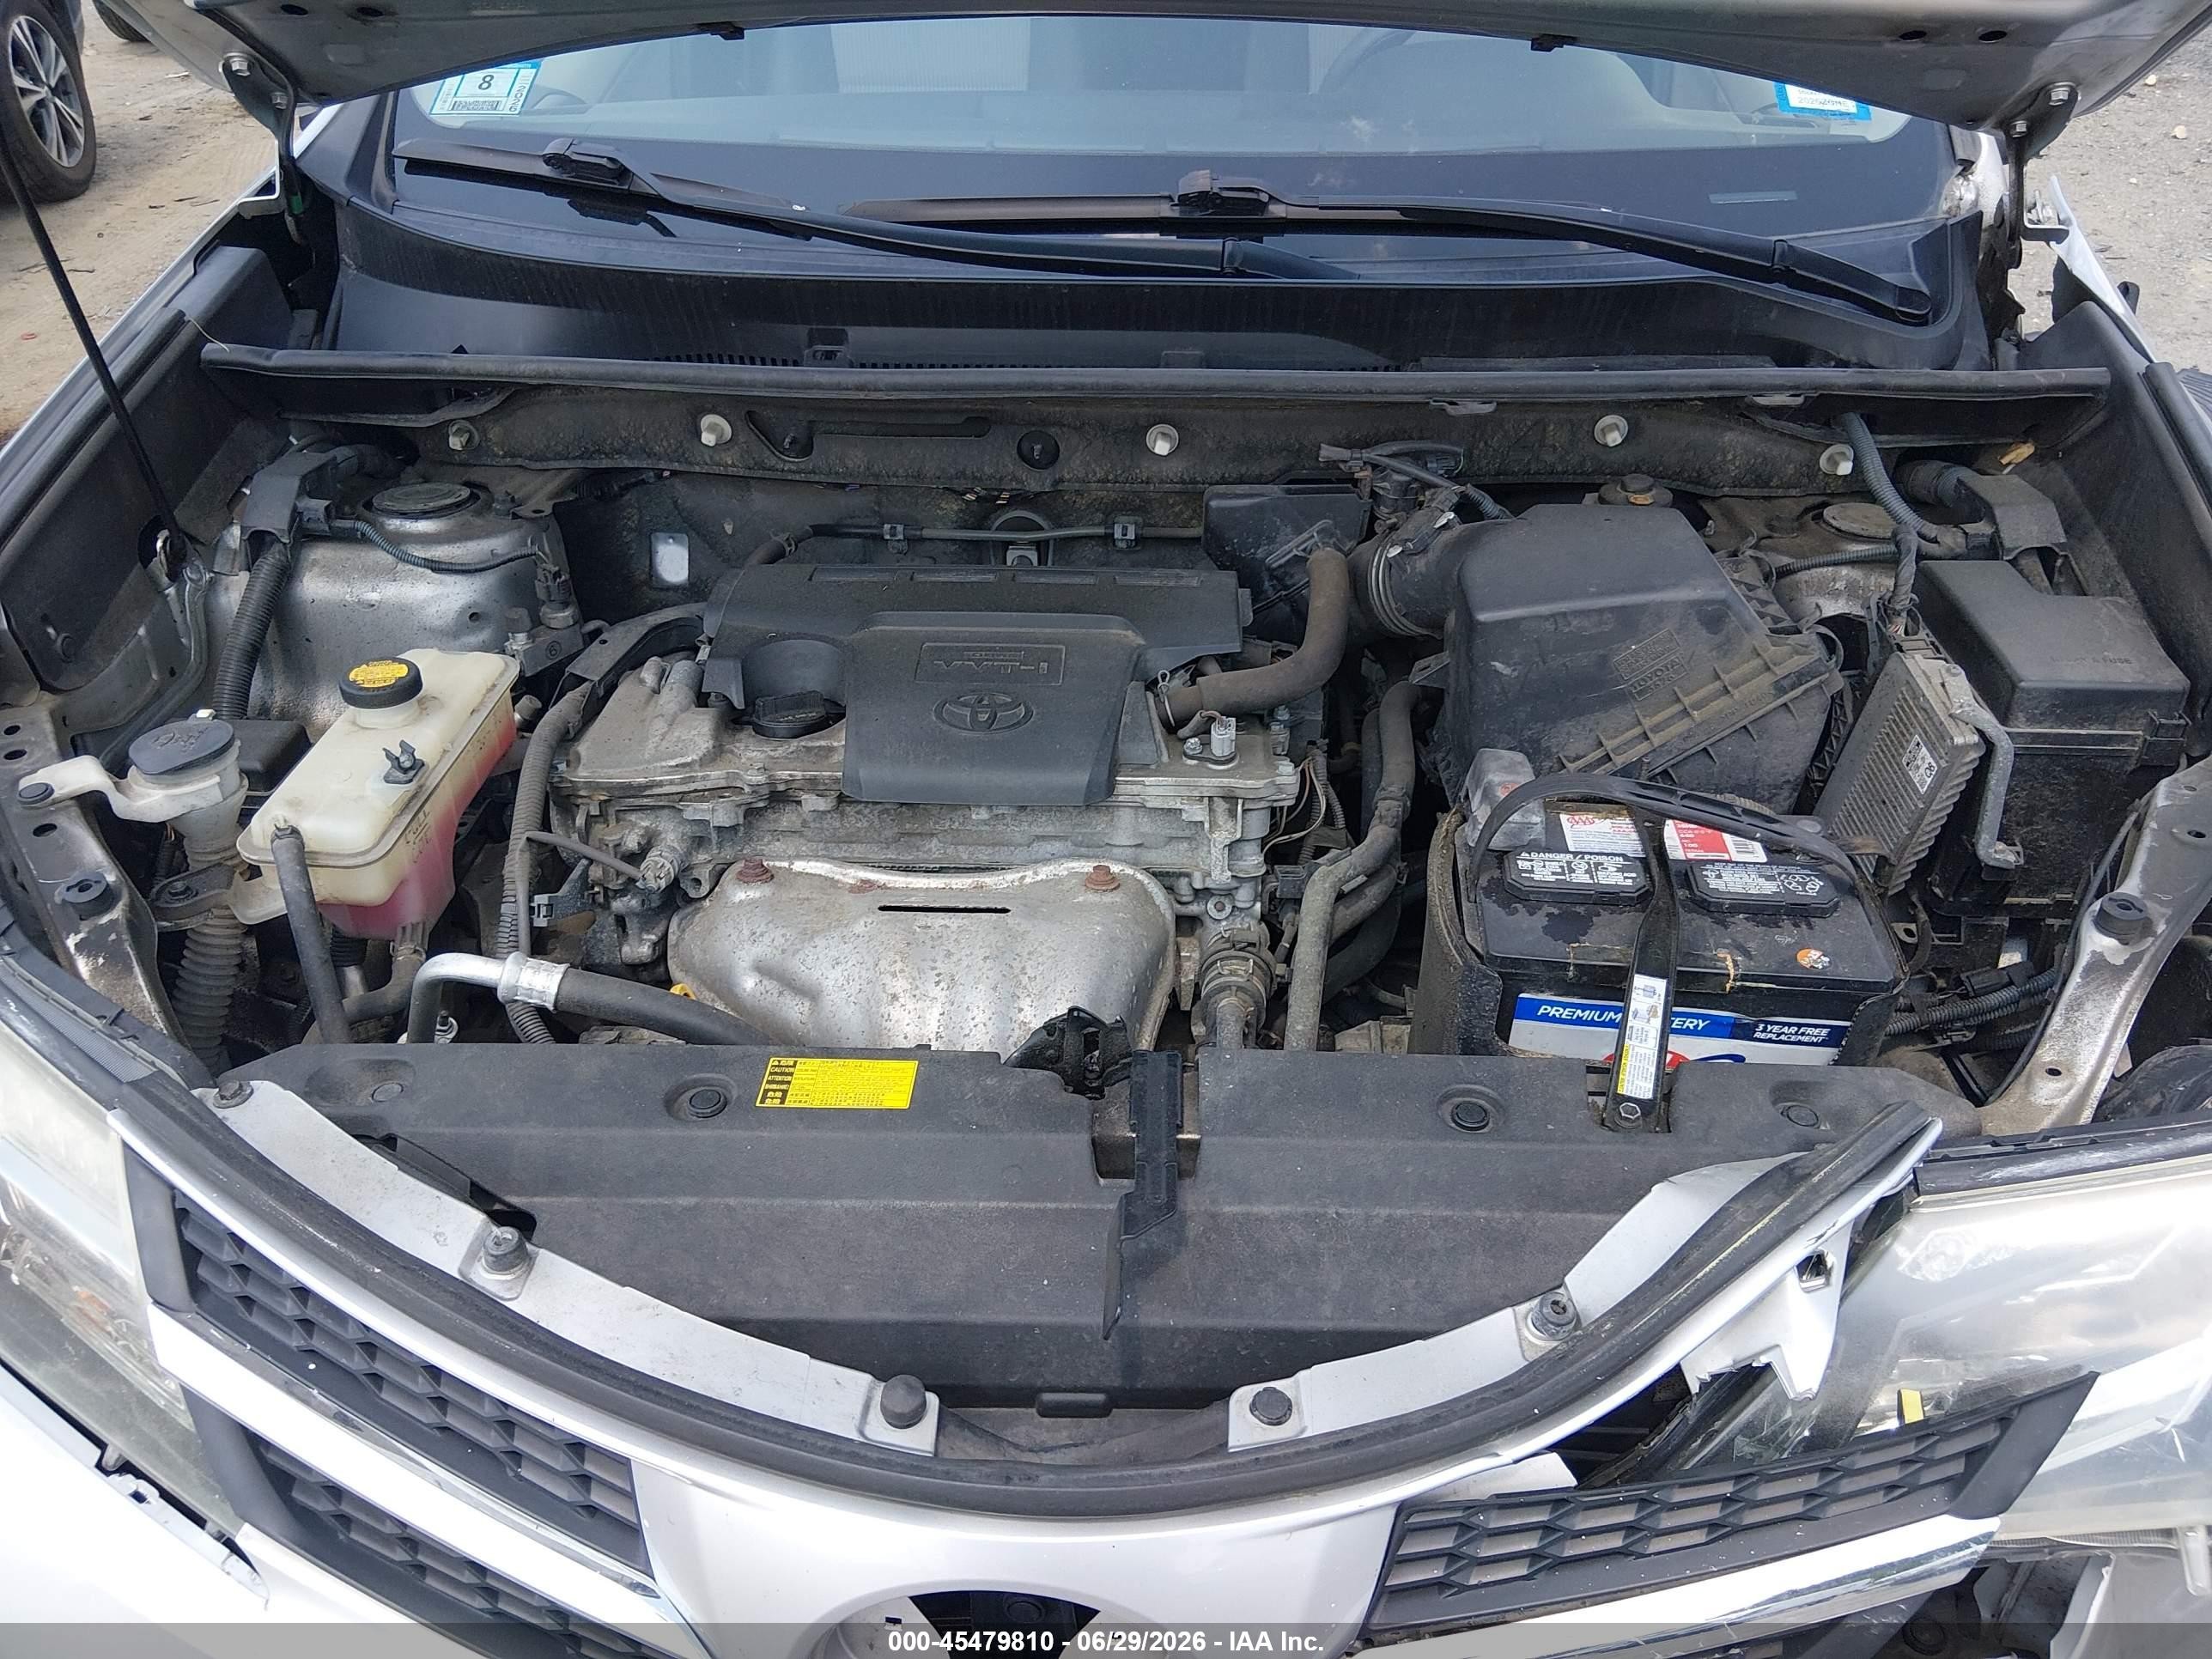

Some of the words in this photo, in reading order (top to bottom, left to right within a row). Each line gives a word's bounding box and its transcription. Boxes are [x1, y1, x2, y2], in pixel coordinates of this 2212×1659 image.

[477, 74, 495, 91] 8
[1566, 815, 1595, 825] AAA
[1537, 1005, 1622, 1024] PREMIUM
[1766, 1024, 1798, 1034] YEAR
[1798, 1027, 1831, 1036] FREE
